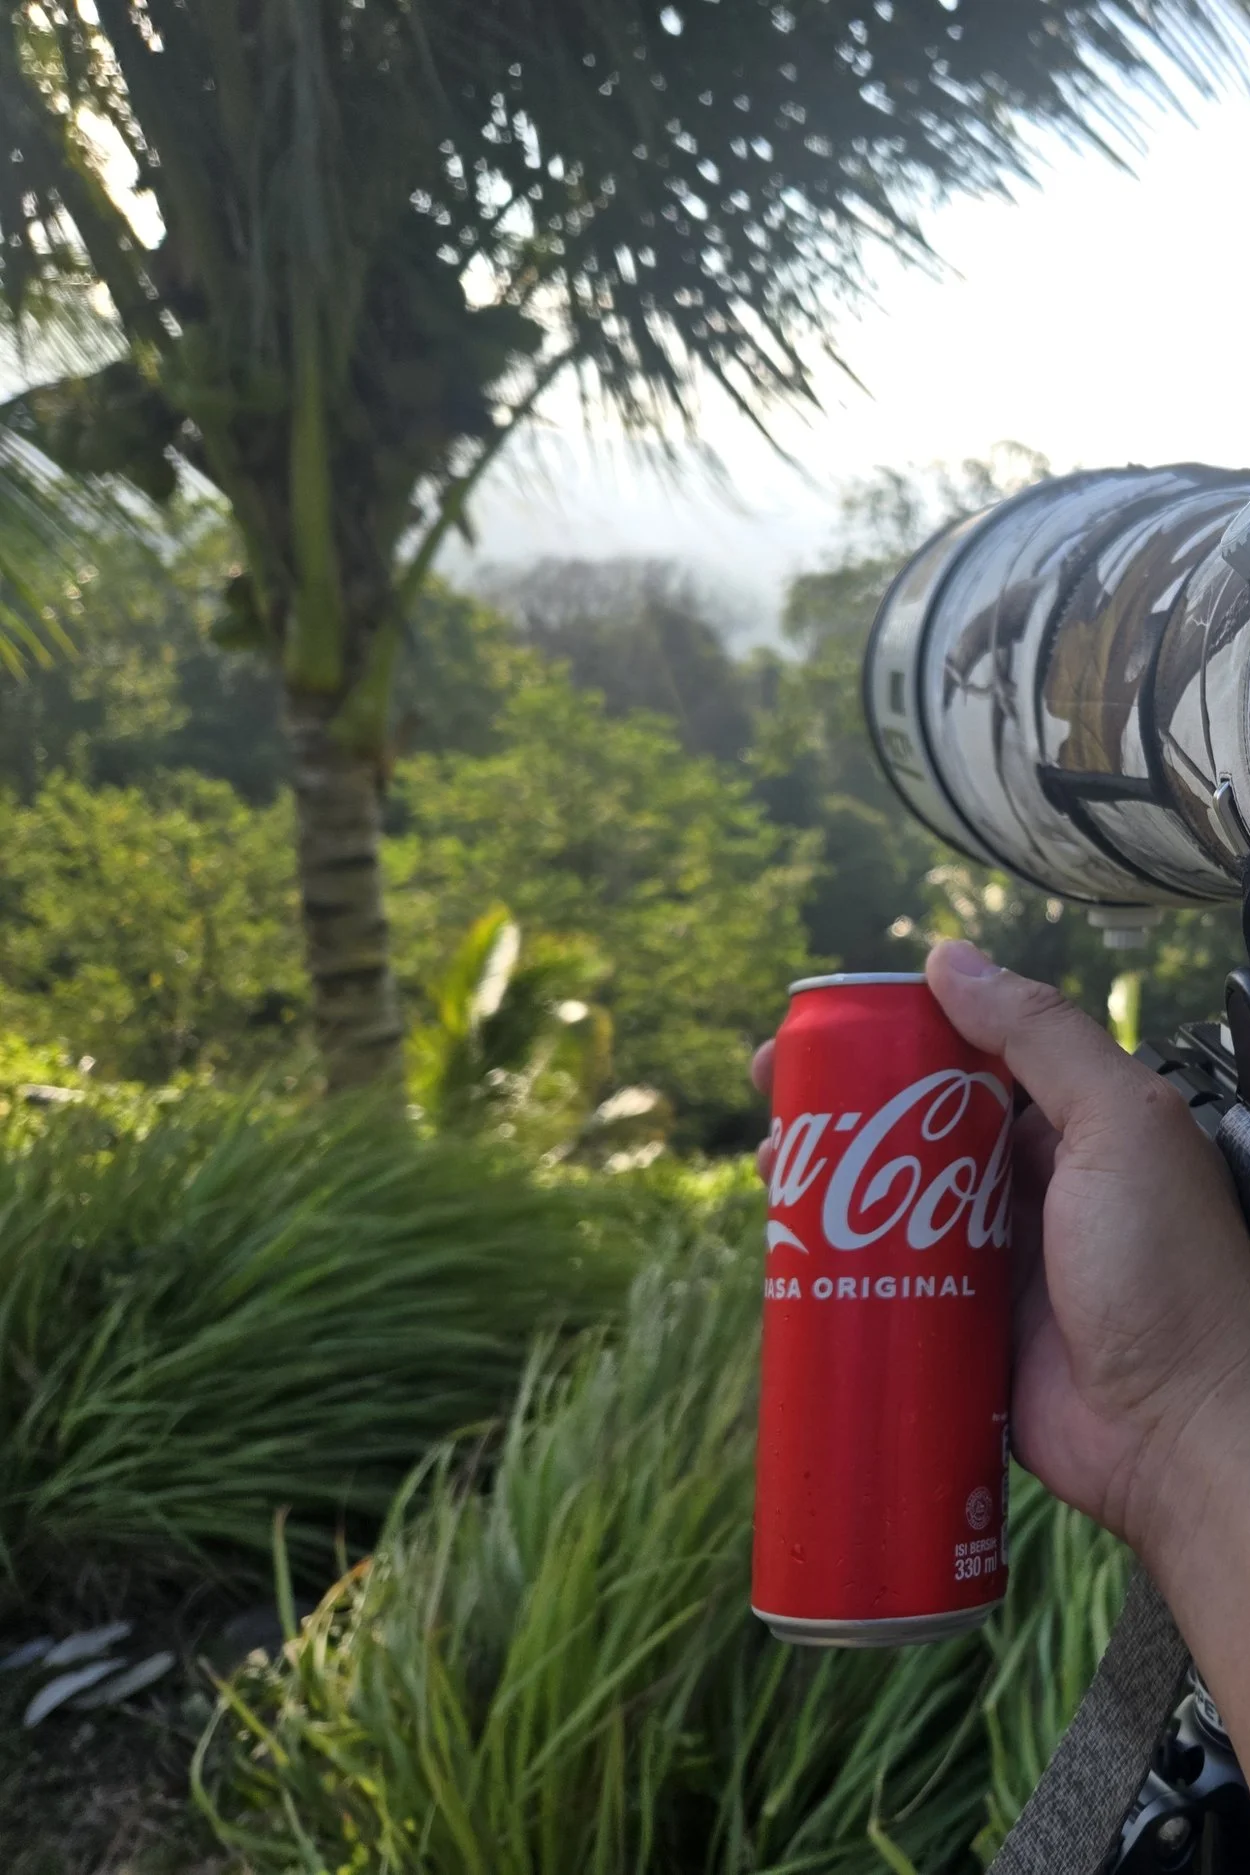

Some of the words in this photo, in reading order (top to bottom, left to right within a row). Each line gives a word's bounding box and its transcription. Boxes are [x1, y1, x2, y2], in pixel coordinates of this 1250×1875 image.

[812, 1275, 976, 1299] ORIGINAL
[954, 1543, 968, 1558] ISI
[954, 1556, 981, 1580] 330
[984, 1550, 998, 1574] ml
